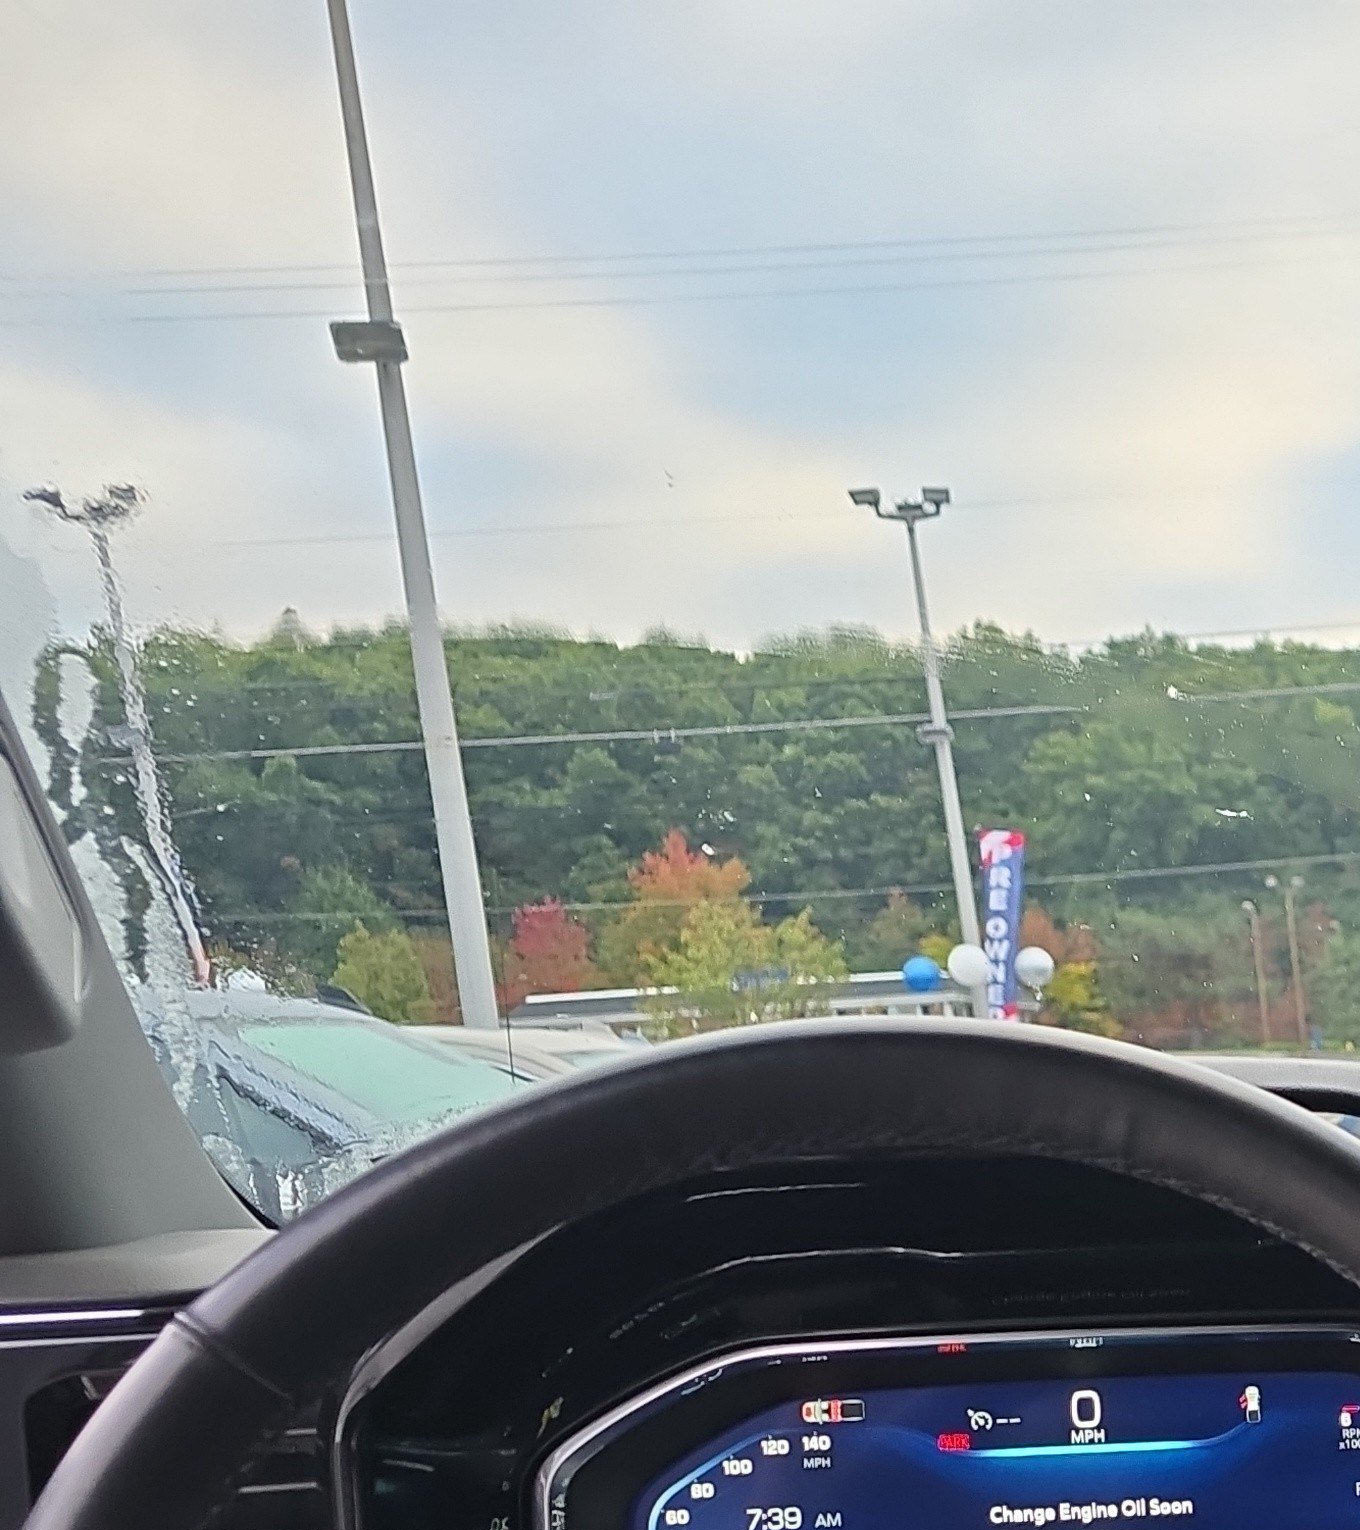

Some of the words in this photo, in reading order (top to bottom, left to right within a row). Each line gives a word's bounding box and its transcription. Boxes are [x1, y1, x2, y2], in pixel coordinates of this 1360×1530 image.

[1070, 1389, 1102, 1429] 0
[802, 1435, 831, 1451] 140
[1071, 1429, 1105, 1444] MPH
[761, 1439, 790, 1456] 120
[722, 1459, 753, 1475] 100
[803, 1457, 831, 1469] MPH
[690, 1482, 715, 1499] 80
[665, 1509, 690, 1525] 60
[989, 1505, 1056, 1526] Change
[1059, 1502, 1118, 1524] Engine
[1121, 1497, 1147, 1517] Oil
[1149, 1497, 1193, 1516] Soon
[814, 1512, 842, 1528] AM
